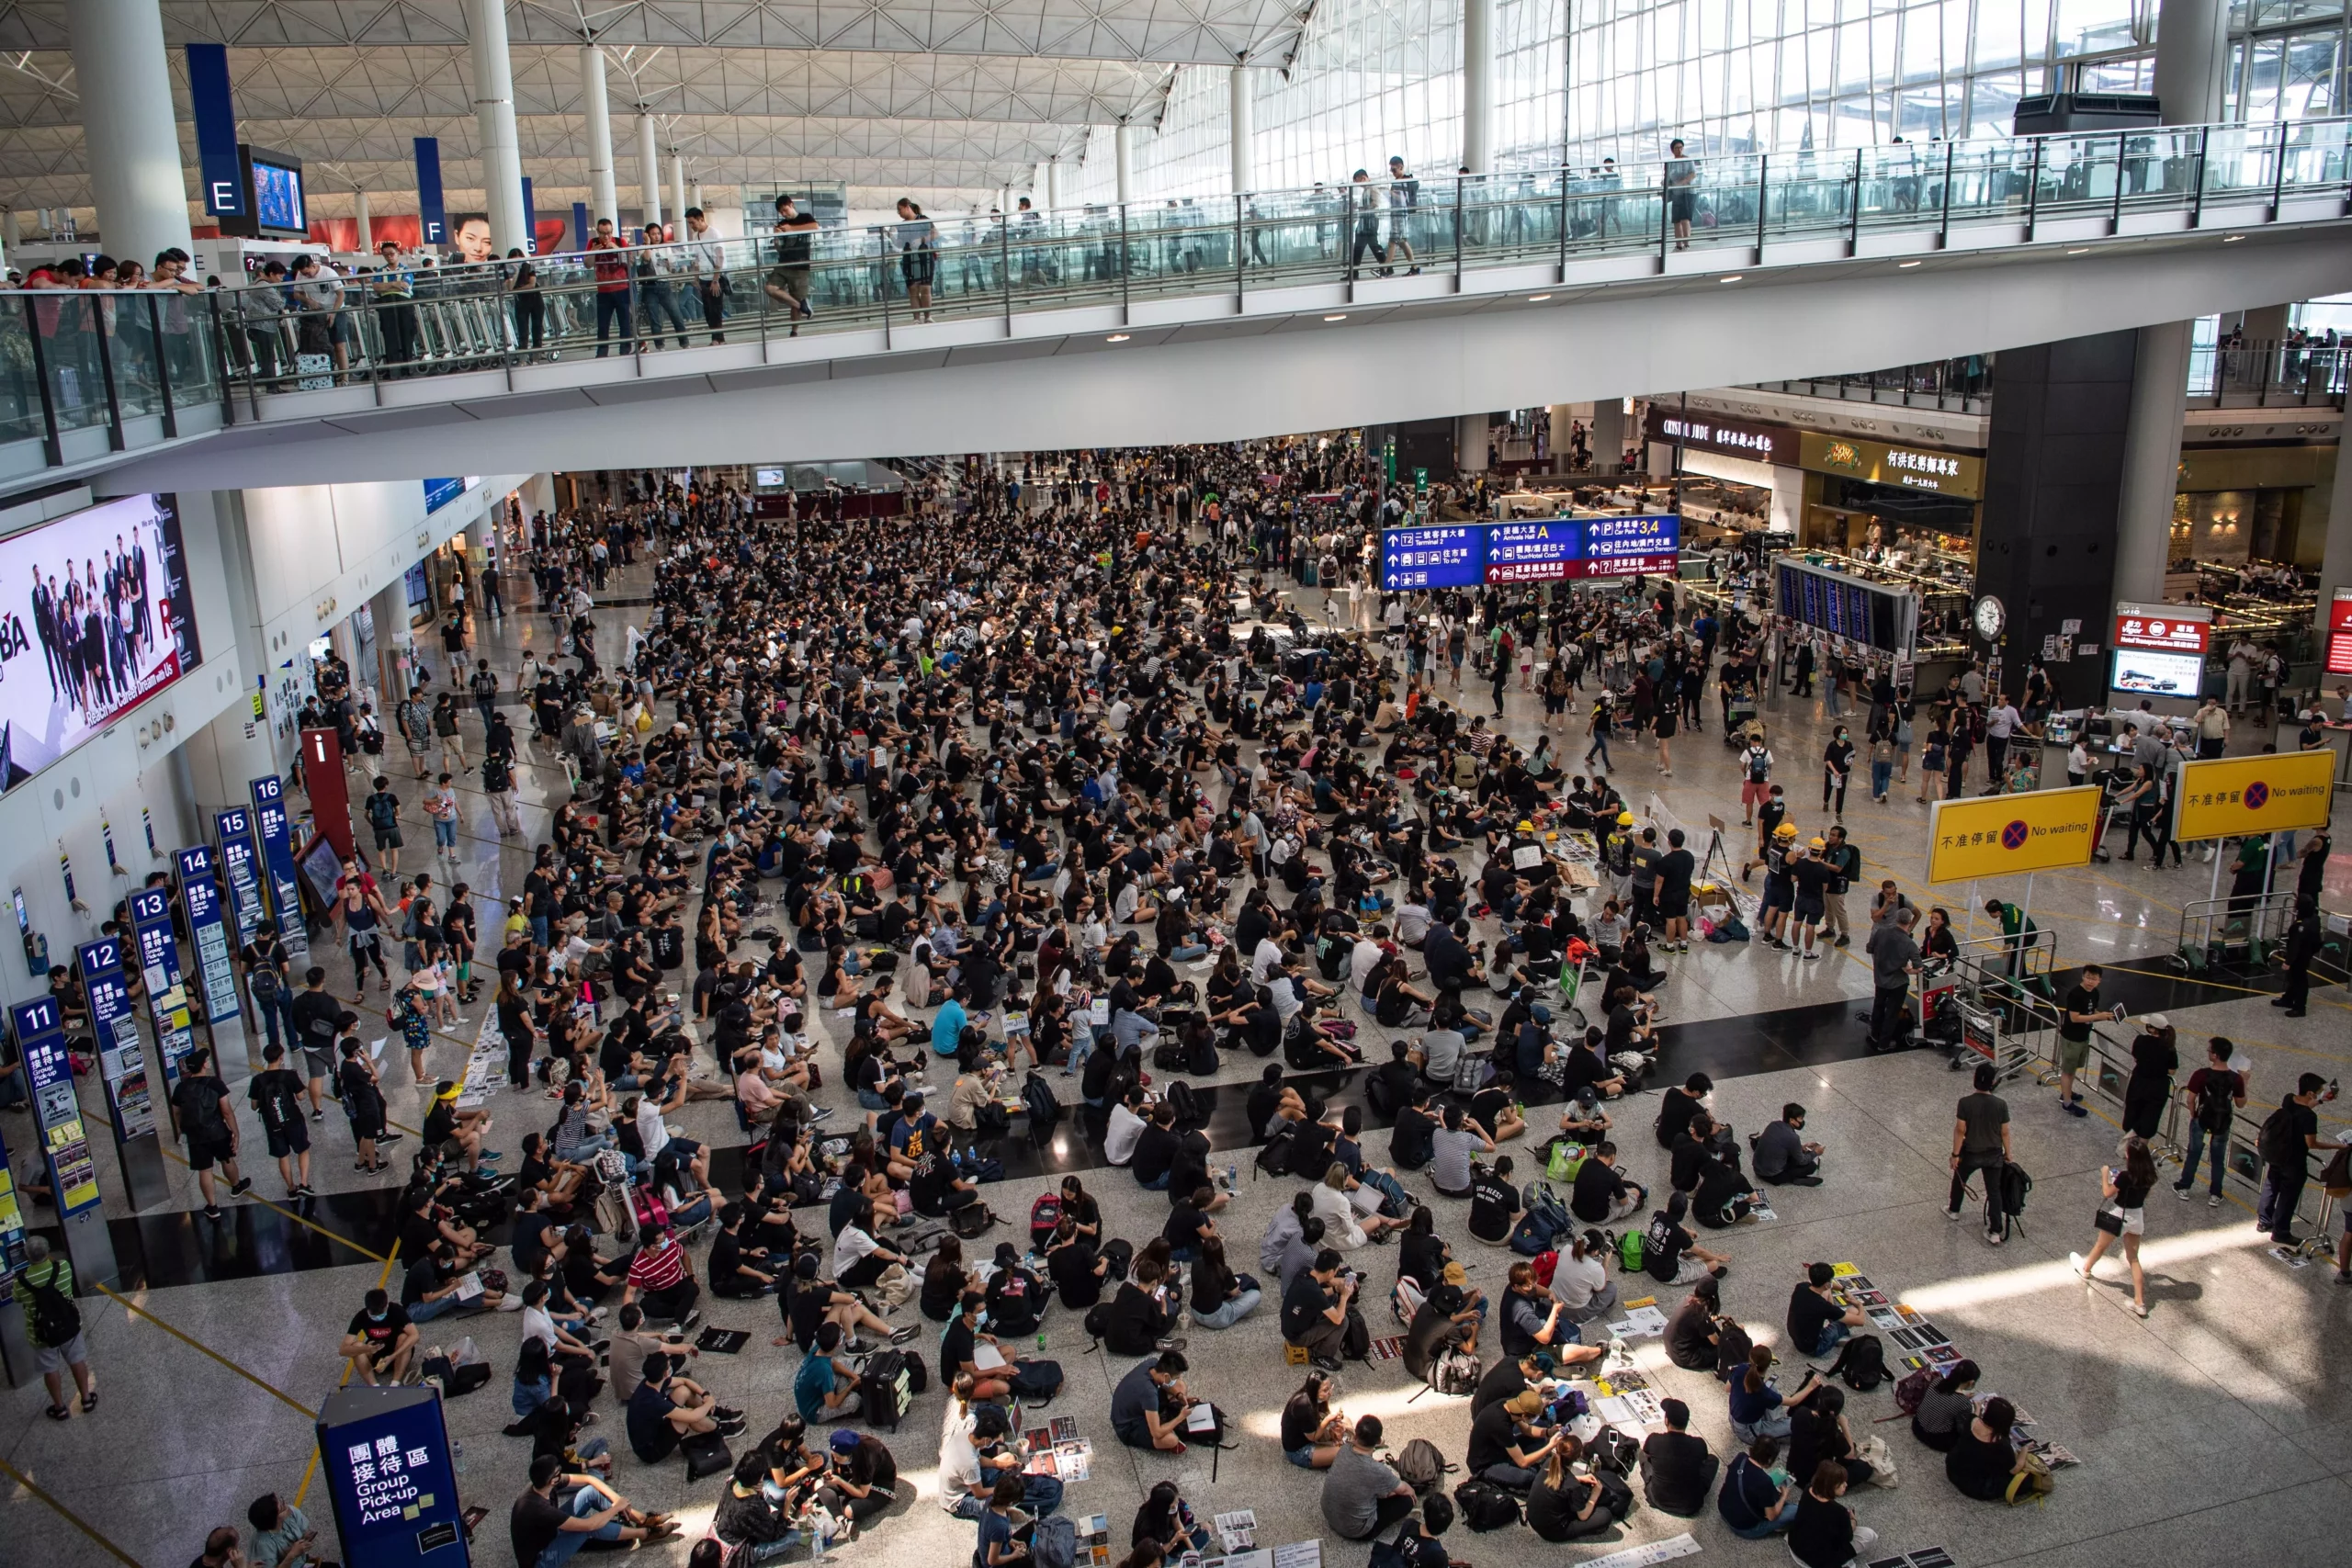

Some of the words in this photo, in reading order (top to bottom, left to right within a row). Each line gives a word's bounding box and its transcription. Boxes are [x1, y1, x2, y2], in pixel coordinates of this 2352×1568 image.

[211, 182, 236, 210] E
[428, 222, 441, 241] F
[526, 239, 537, 254] G
[194, 254, 206, 271] E
[1887, 449, 1959, 477] 何洪記粥麵專家
[1503, 525, 1536, 536] 接機大堂
[1615, 520, 1638, 529] 停車場
[1639, 520, 1659, 536] 3,4
[1415, 529, 1466, 540] 二號客運大樓
[1537, 525, 1549, 539] A
[1402, 535, 1413, 545] T2
[1442, 548, 1467, 558] 往市區
[1613, 547, 1655, 555] Mainland/Macao
[1655, 545, 1678, 553] Transport
[1450, 557, 1461, 565] city
[1515, 562, 1565, 573] 富豪機場酒店
[1613, 558, 1645, 568] 旅客服務
[1515, 572, 1530, 581] Regal
[1531, 571, 1549, 580] Airport
[2120, 636, 2135, 644] Hotel
[86, 704, 107, 728] Reach
[118, 684, 138, 708] Career
[137, 673, 157, 695] Dream
[164, 662, 174, 678] Us
[258, 780, 278, 798] 16
[2271, 787, 2286, 798] No
[2289, 784, 2325, 797] waiting
[2188, 790, 2241, 808] 不准停留
[222, 814, 244, 832] 15
[2031, 825, 2047, 837] No
[2050, 821, 2088, 835] waiting
[1940, 830, 1998, 851] 不准停留
[184, 852, 208, 872] 14
[137, 895, 163, 917] 13
[87, 944, 116, 969] 12
[145, 946, 163, 955] Group
[146, 951, 165, 960] Pick-up
[147, 957, 160, 966] Area
[96, 1000, 115, 1011] Group
[96, 1005, 118, 1016] Pick-up
[26, 1005, 51, 1031] 11
[98, 1013, 112, 1022] Area
[33, 1063, 54, 1077] Group
[34, 1067, 58, 1083] Pick-up
[35, 1077, 52, 1089] Area
[1485, 1194, 1496, 1203] KONG
[1486, 1187, 1503, 1200] BLESS
[347, 1435, 400, 1465] 團體
[351, 1446, 430, 1484] 接待區
[356, 1474, 410, 1497] Group
[358, 1485, 418, 1511] Pick-up
[362, 1505, 401, 1525] Area
